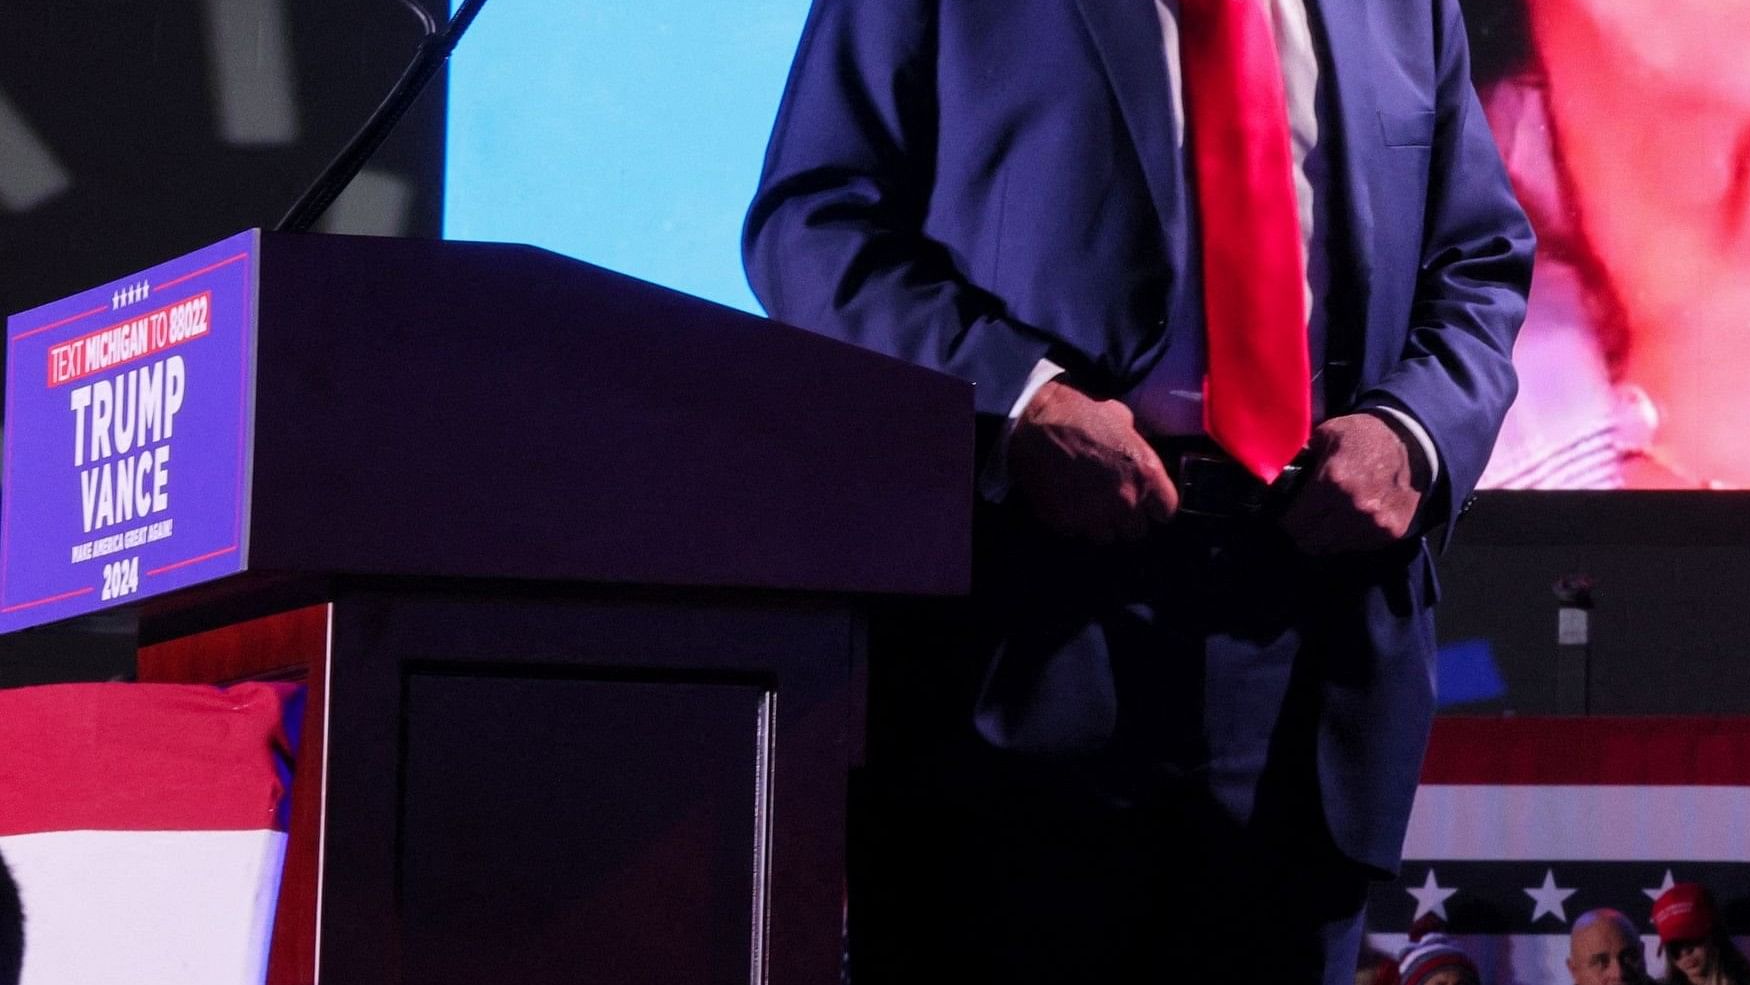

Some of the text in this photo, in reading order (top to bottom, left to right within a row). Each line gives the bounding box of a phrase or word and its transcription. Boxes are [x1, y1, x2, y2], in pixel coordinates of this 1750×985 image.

[51, 295, 208, 383] TEXT MICHIGAN TO 88022
[70, 355, 186, 467] TRUMP
[80, 444, 170, 533] VANCE
[71, 541, 93, 564] MAKE
[124, 526, 148, 549] GREAT
[101, 556, 139, 601] 2024
